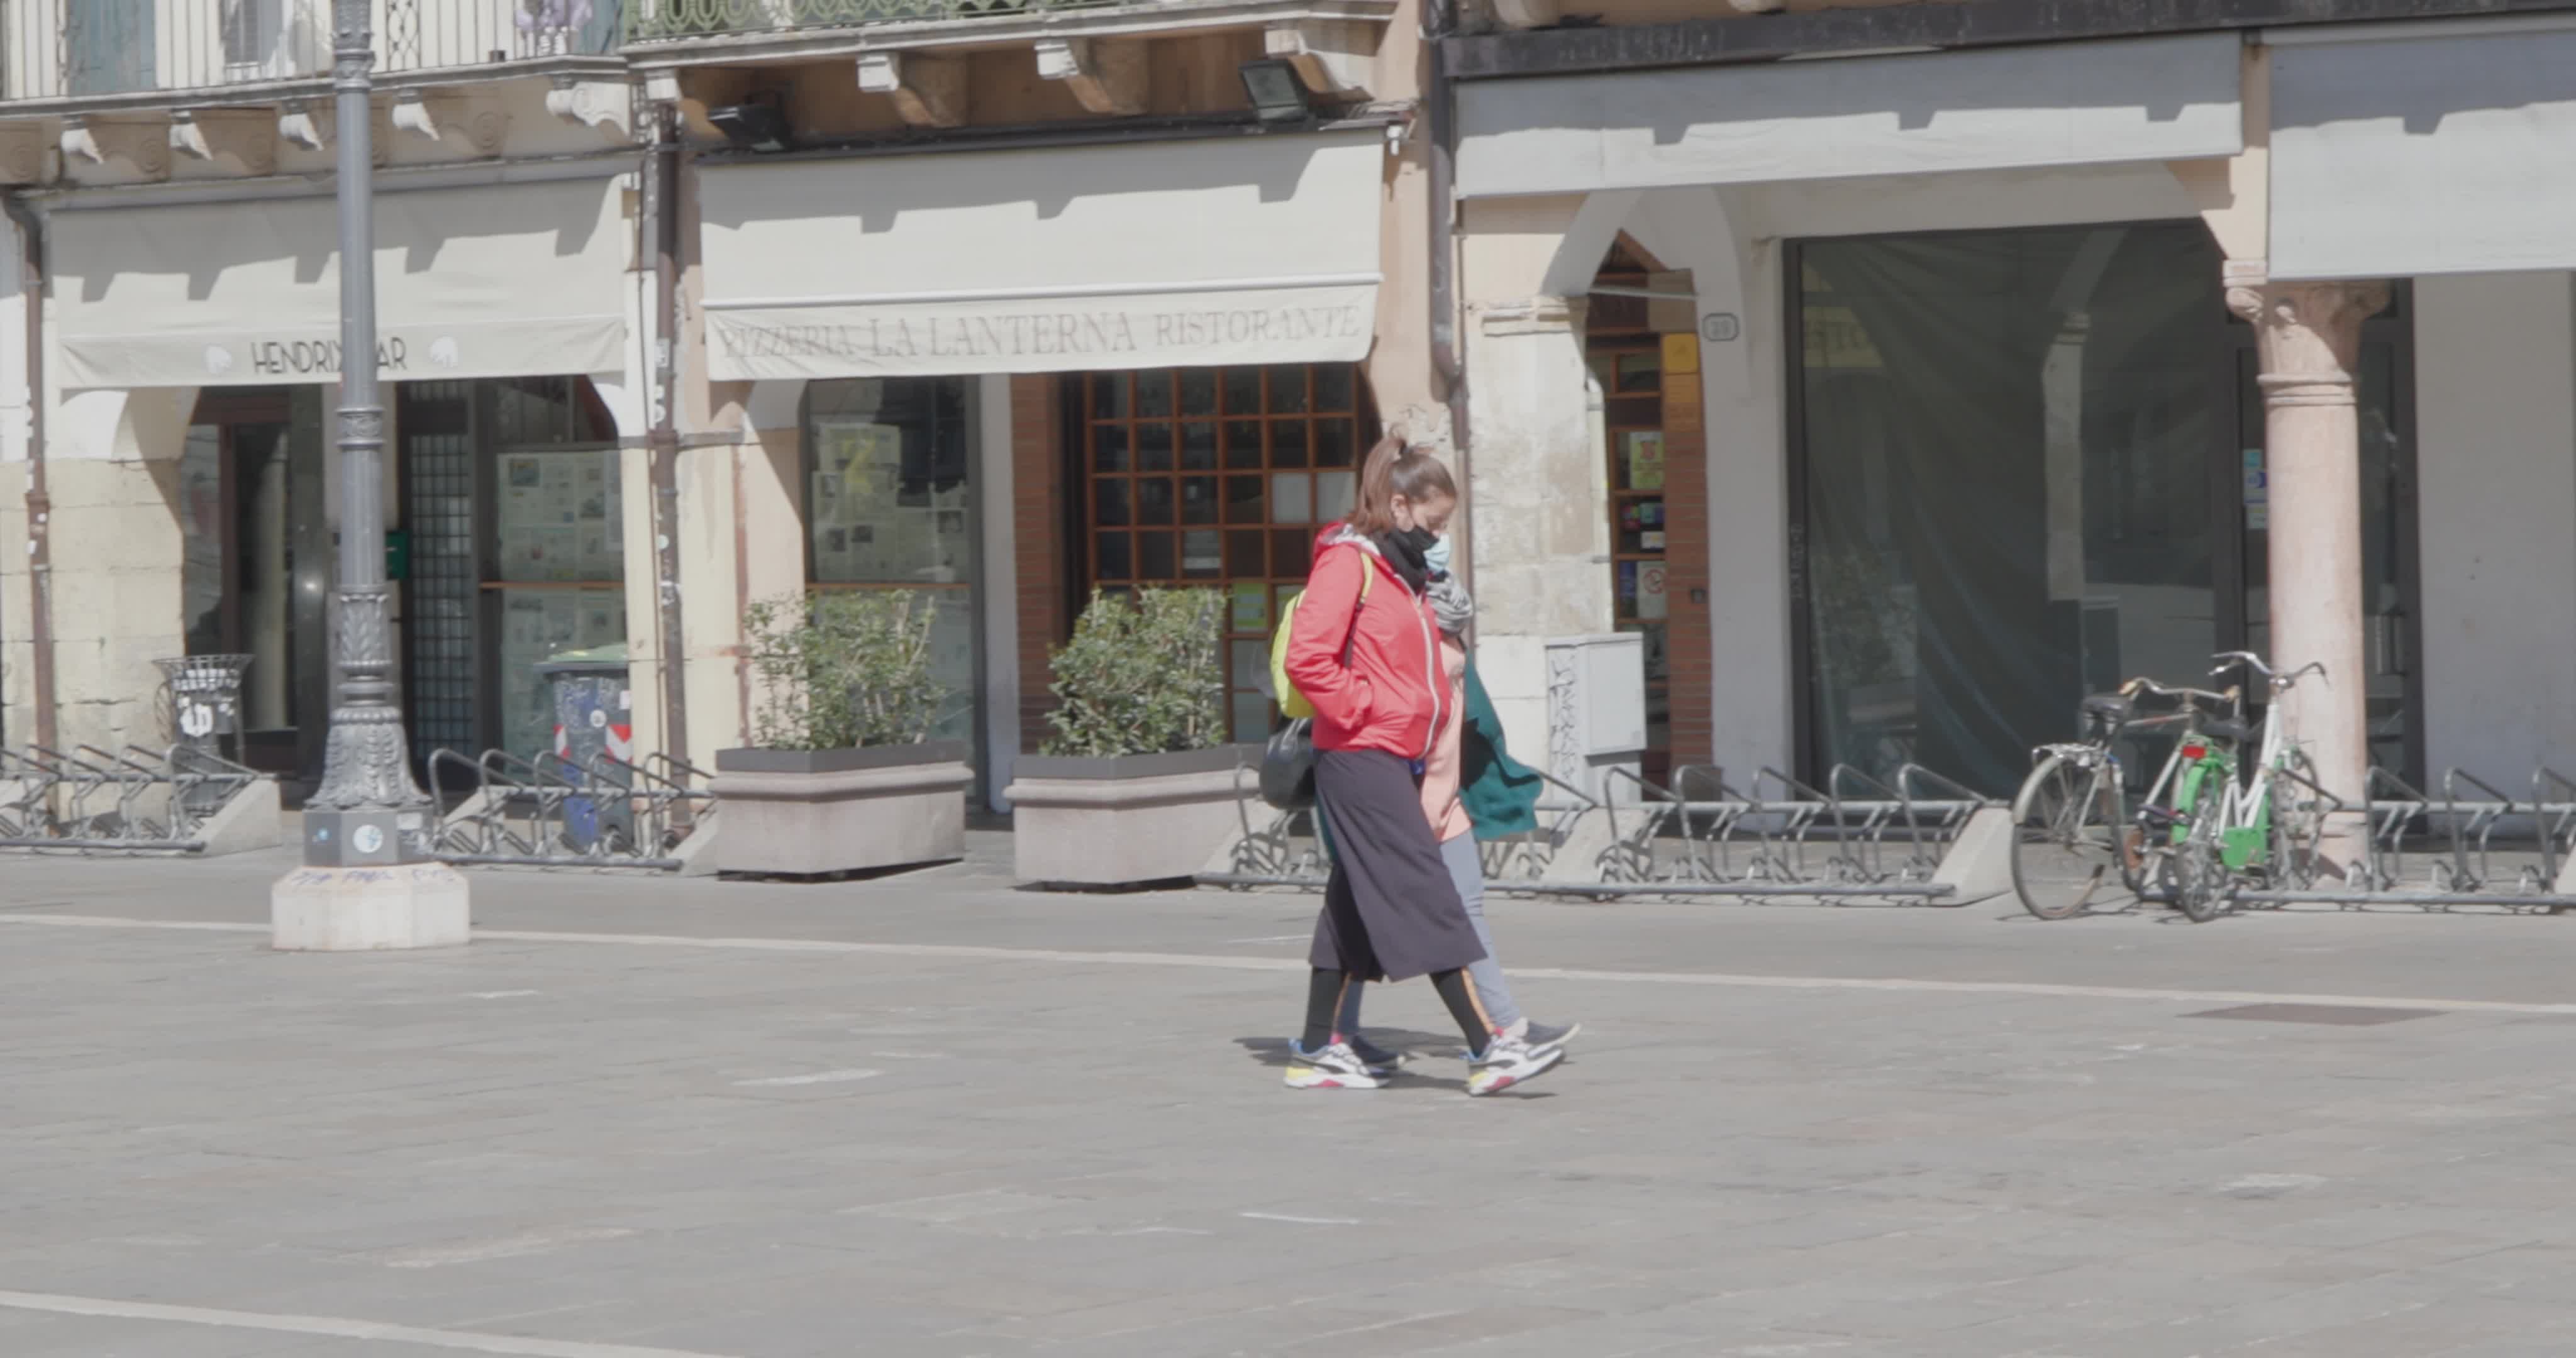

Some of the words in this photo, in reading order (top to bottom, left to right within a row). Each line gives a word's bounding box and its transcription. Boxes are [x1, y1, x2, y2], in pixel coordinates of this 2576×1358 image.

[868, 318, 918, 357] LA
[928, 312, 1137, 356] LANTERNA
[1153, 305, 1360, 346] RISTORANTE
[377, 336, 408, 371] AR
